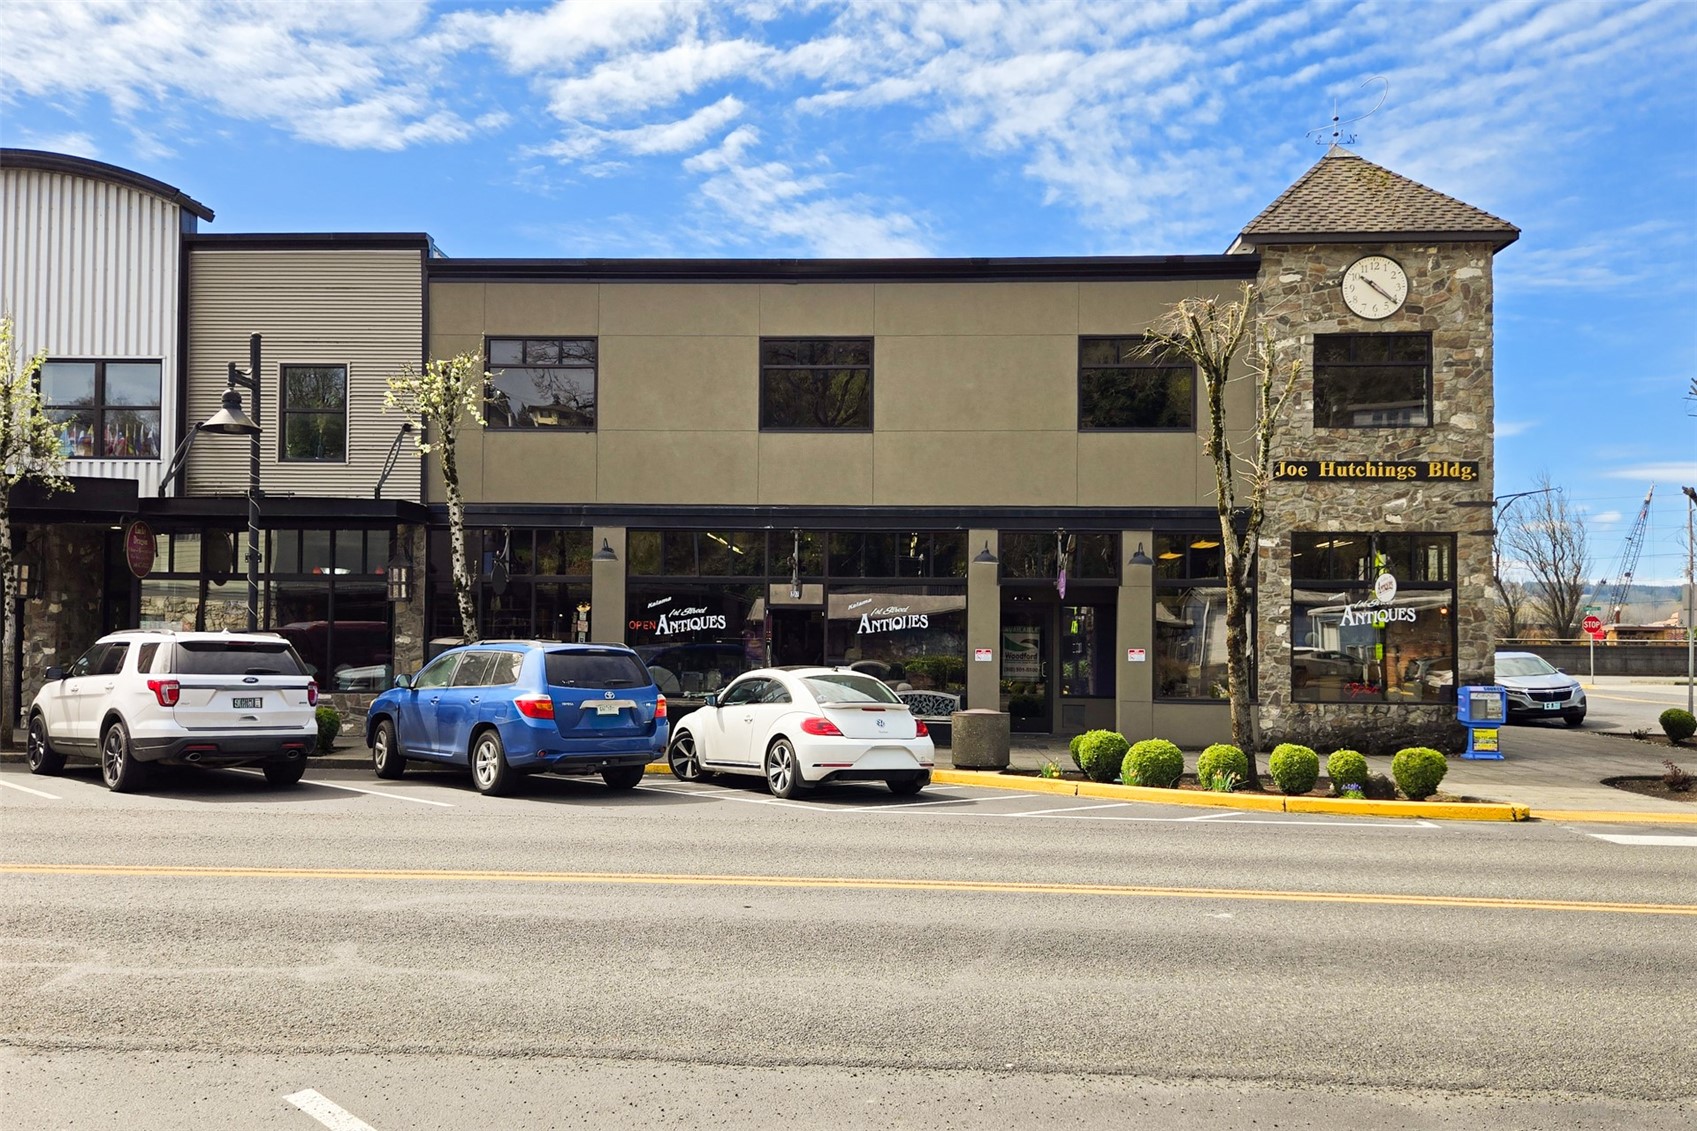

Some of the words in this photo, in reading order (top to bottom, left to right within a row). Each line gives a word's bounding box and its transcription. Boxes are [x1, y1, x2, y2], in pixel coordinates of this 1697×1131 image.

[1361, 264, 1368, 273] 11
[1370, 262, 1380, 271] 12
[1352, 272, 1361, 281] 10
[1390, 270, 1397, 280] 2
[1349, 284, 1355, 293] 9
[1396, 283, 1401, 292] 3
[1352, 295, 1358, 303] 8
[1361, 303, 1367, 311] 7
[1372, 304, 1378, 313] 6
[1383, 301, 1389, 310] 5
[1275, 461, 1308, 478] Joe
[1318, 461, 1417, 480] Hutchings
[1427, 461, 1478, 480] Bldg.
[681, 606, 708, 616] Street
[882, 606, 910, 615] Street
[628, 620, 657, 630] OPEN
[1583, 621, 1601, 629] STOP
[1004, 651, 1038, 660] Woodford
